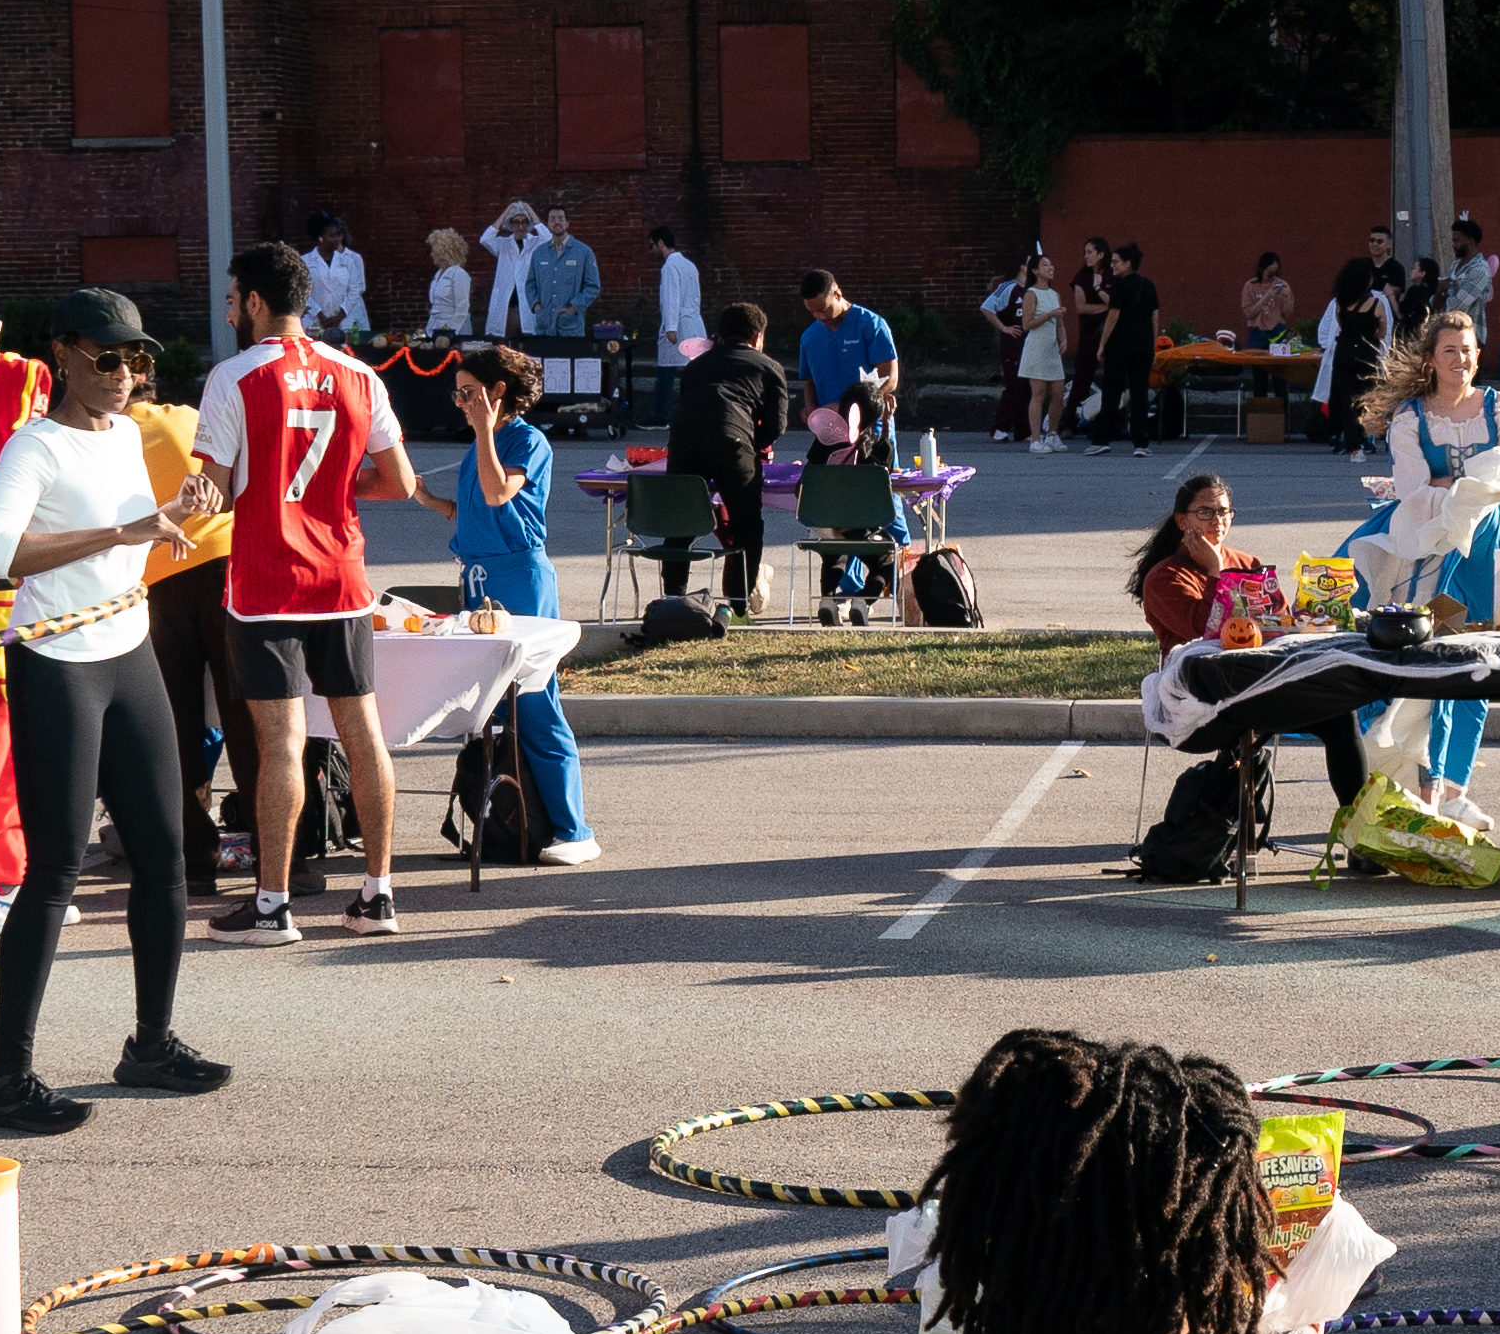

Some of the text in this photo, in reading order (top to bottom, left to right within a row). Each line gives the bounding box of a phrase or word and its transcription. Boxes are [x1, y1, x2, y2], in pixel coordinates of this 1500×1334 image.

[283, 369, 334, 395] SAKA
[283, 408, 337, 503] 7
[255, 919, 279, 929] HOKA
